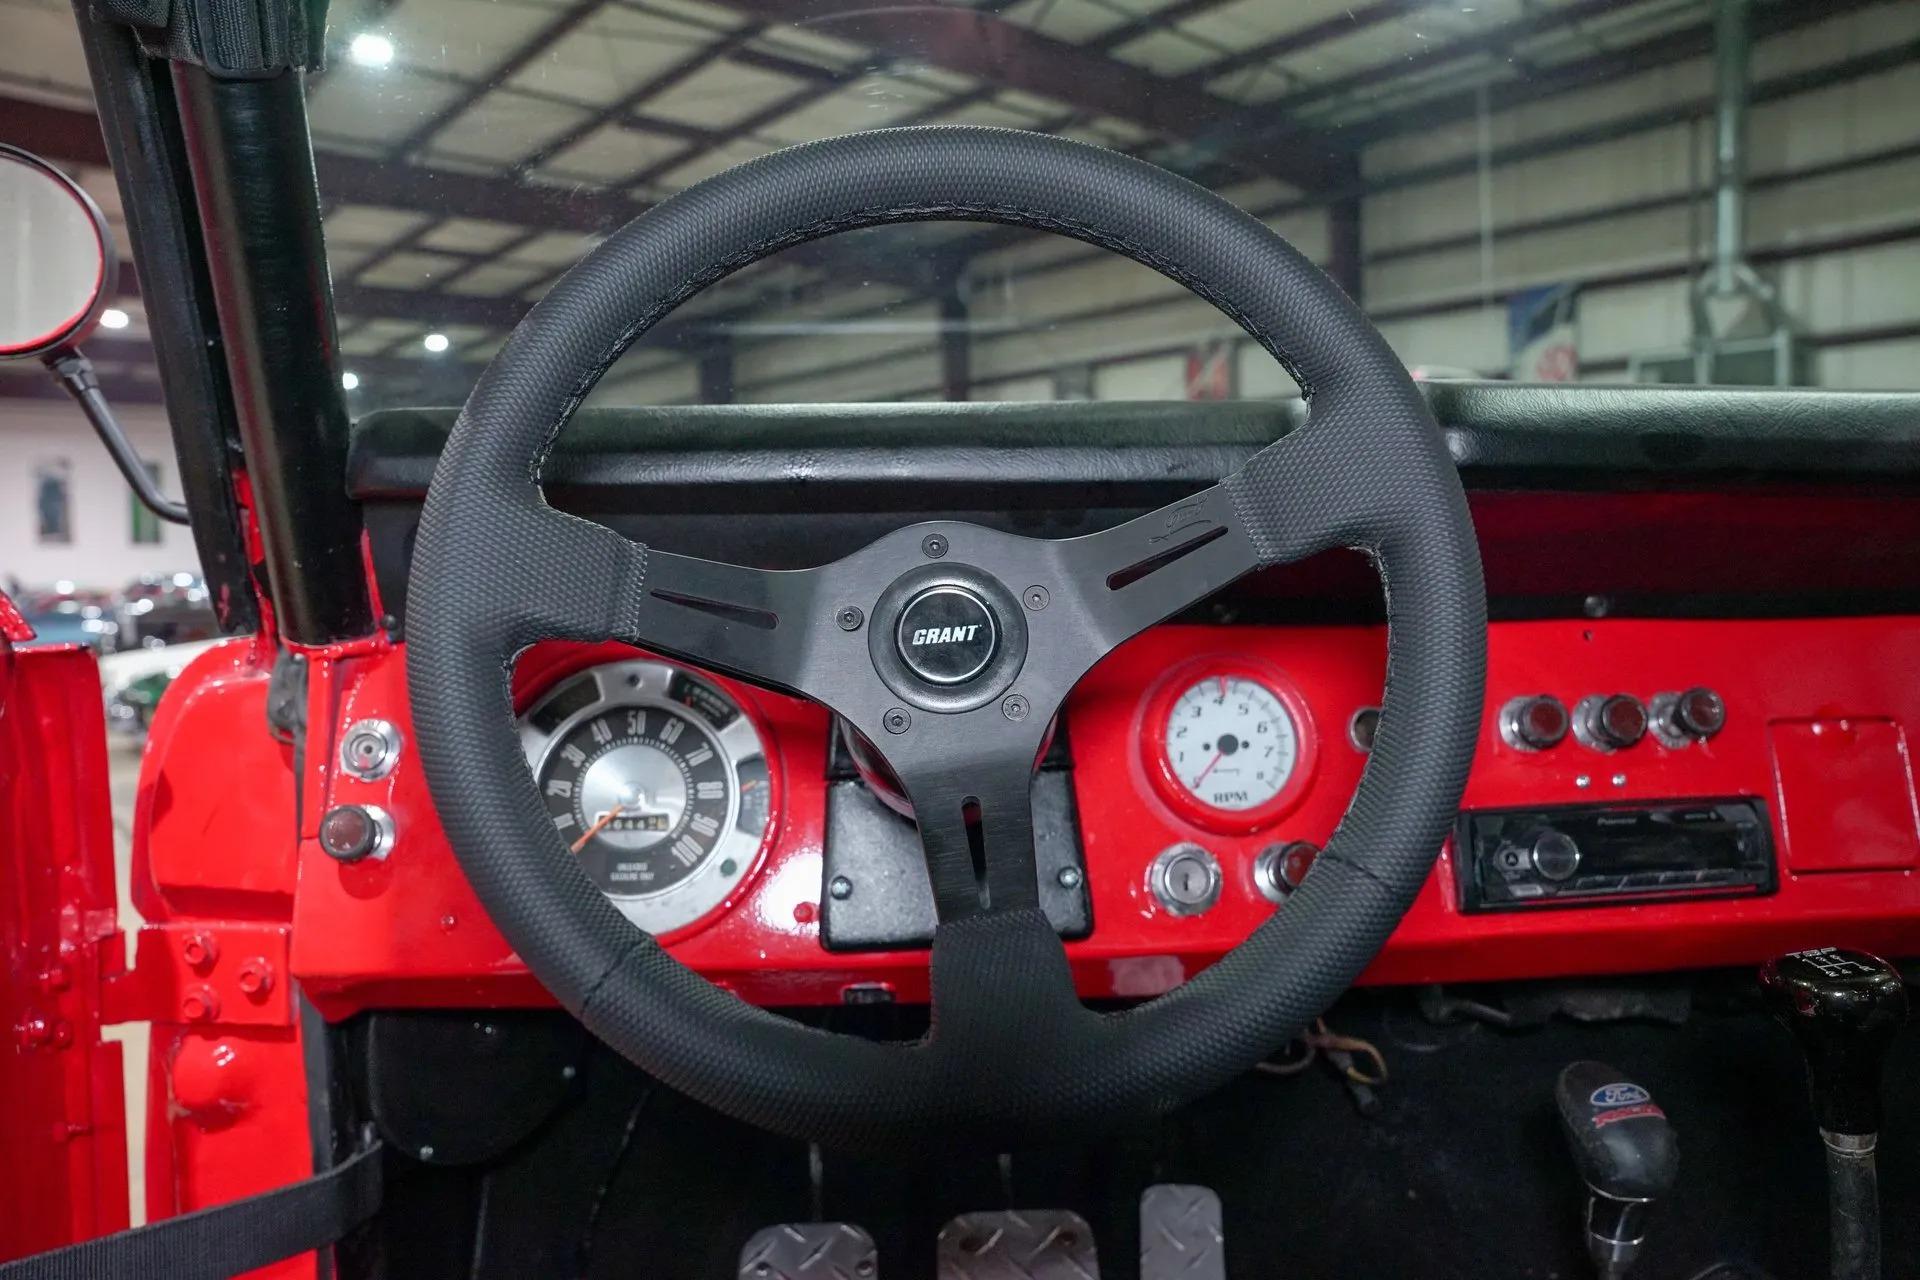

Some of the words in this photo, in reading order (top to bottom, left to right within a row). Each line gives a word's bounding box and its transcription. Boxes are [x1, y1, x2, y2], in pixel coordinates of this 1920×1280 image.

[912, 624, 979, 645] GRANT
[1213, 694, 1224, 706] 4
[1238, 703, 1249, 716] 5
[1191, 706, 1202, 718] 3
[590, 718, 613, 743] 40
[627, 711, 647, 735] 50
[659, 717, 685, 744] 60
[1176, 726, 1188, 738] 2
[1257, 721, 1268, 734] 6
[560, 743, 586, 768] 30
[686, 742, 714, 767] 70
[1264, 745, 1274, 758] 7
[546, 780, 573, 799] 20
[697, 781, 724, 800] 80
[1213, 791, 1249, 803] RPM
[690, 813, 719, 838] 90
[670, 834, 704, 868] 100
